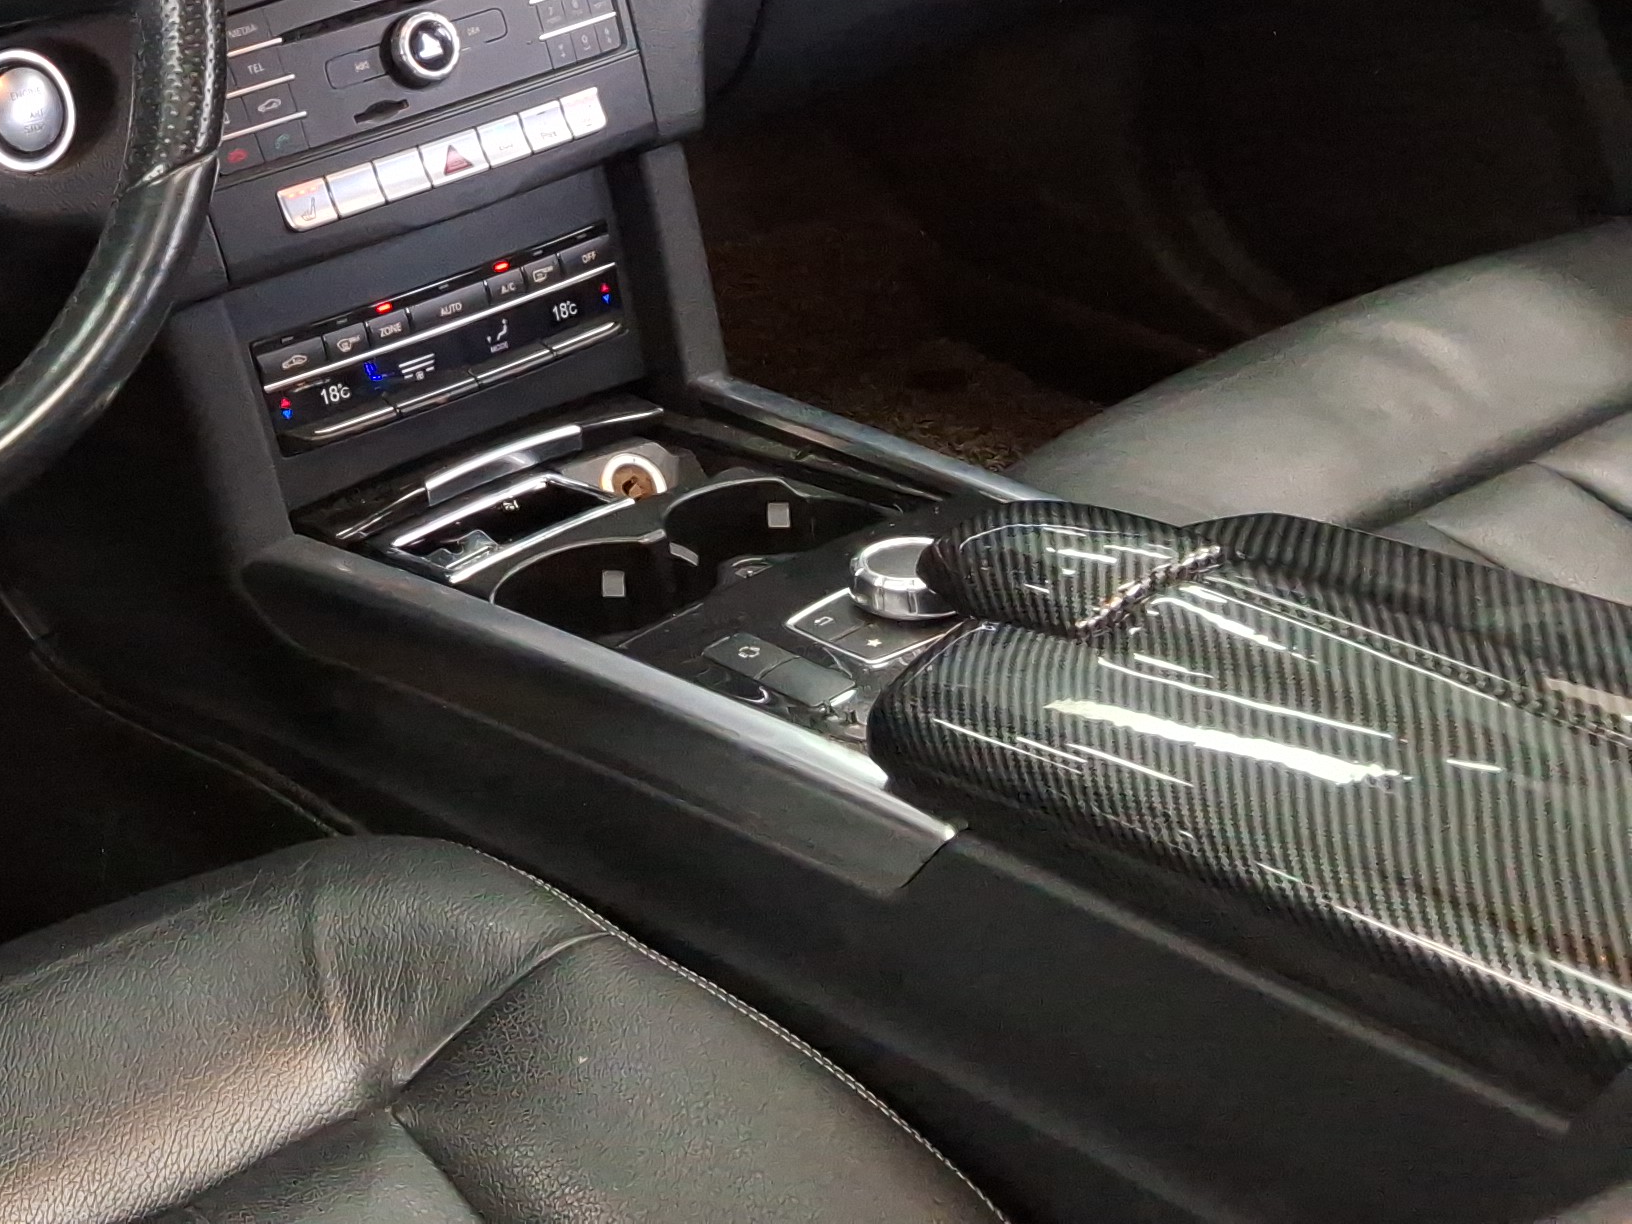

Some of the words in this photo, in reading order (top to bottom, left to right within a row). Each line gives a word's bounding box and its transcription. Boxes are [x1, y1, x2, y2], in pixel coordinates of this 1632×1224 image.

[247, 62, 266, 75] TEL
[581, 249, 596, 264] OFF
[499, 281, 517, 296] A/C
[439, 301, 463, 317] AUTO
[378, 321, 402, 338] ZONE
